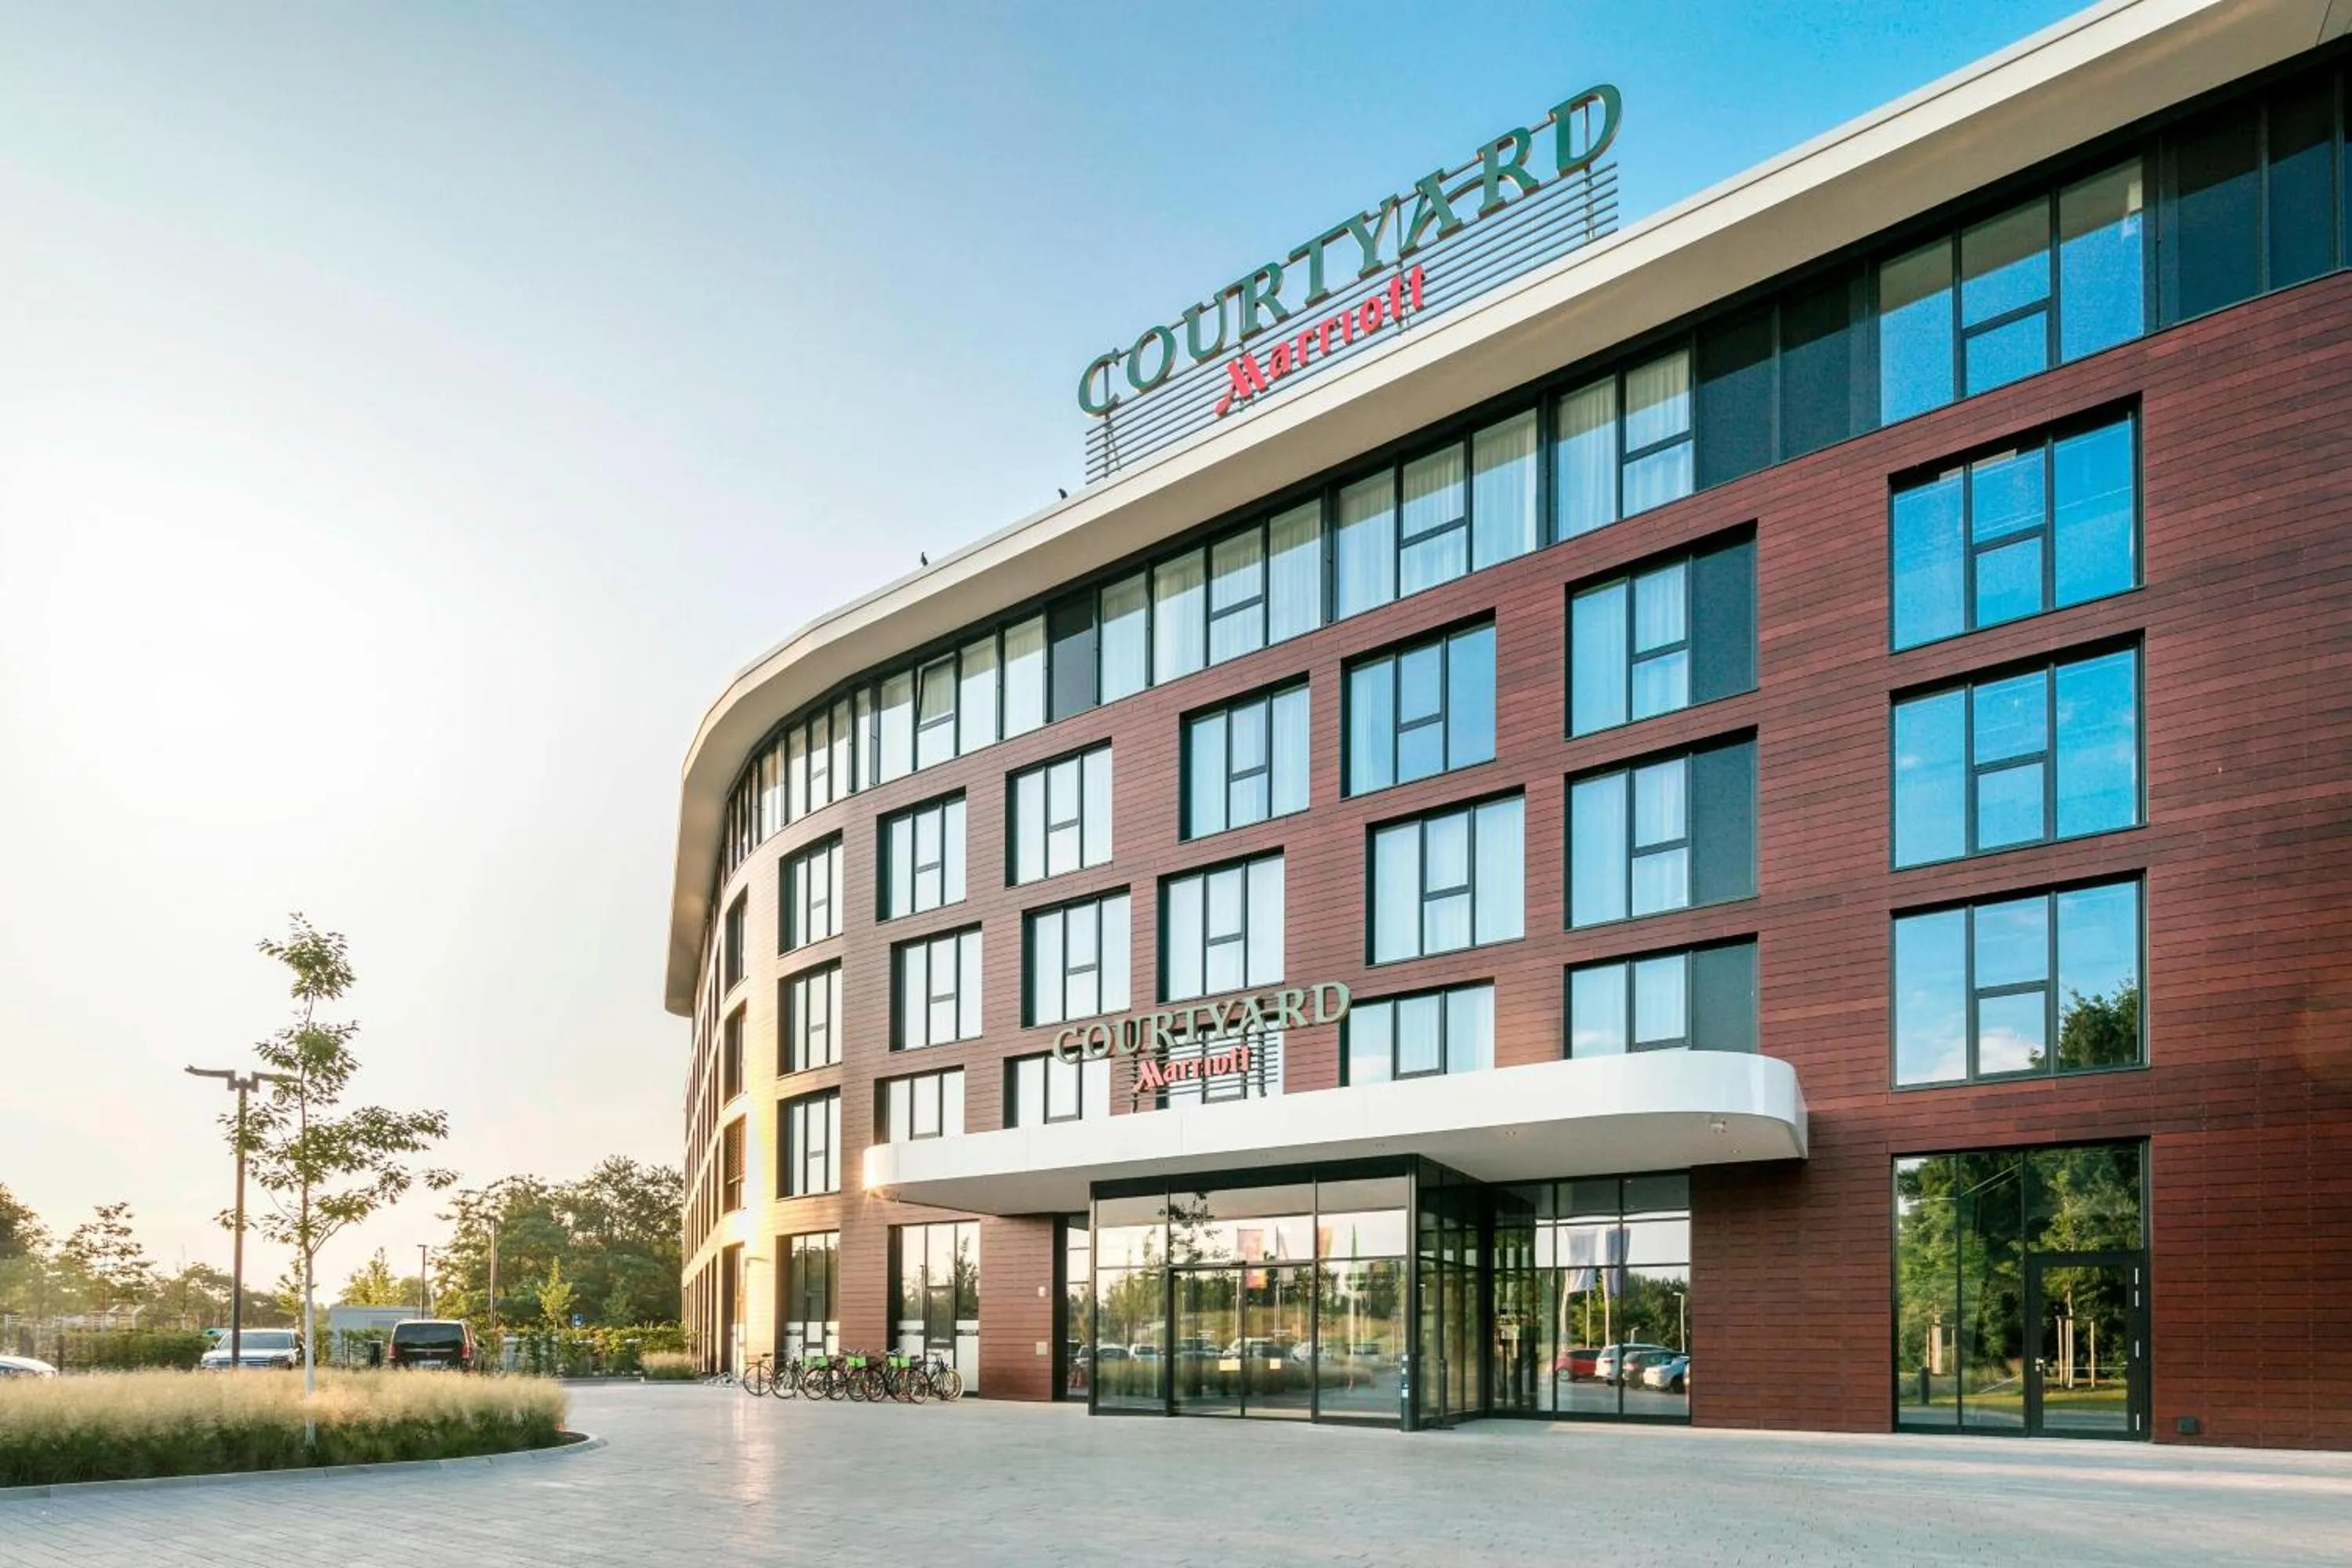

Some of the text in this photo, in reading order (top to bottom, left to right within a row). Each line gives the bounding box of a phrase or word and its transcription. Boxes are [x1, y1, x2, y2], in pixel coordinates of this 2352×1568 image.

[1078, 84, 1623, 418] COURTYARD
[1214, 265, 1425, 417] Marriott
[1054, 982, 1352, 1064] COURTYARD
[1134, 1044, 1253, 1091] Marriott
